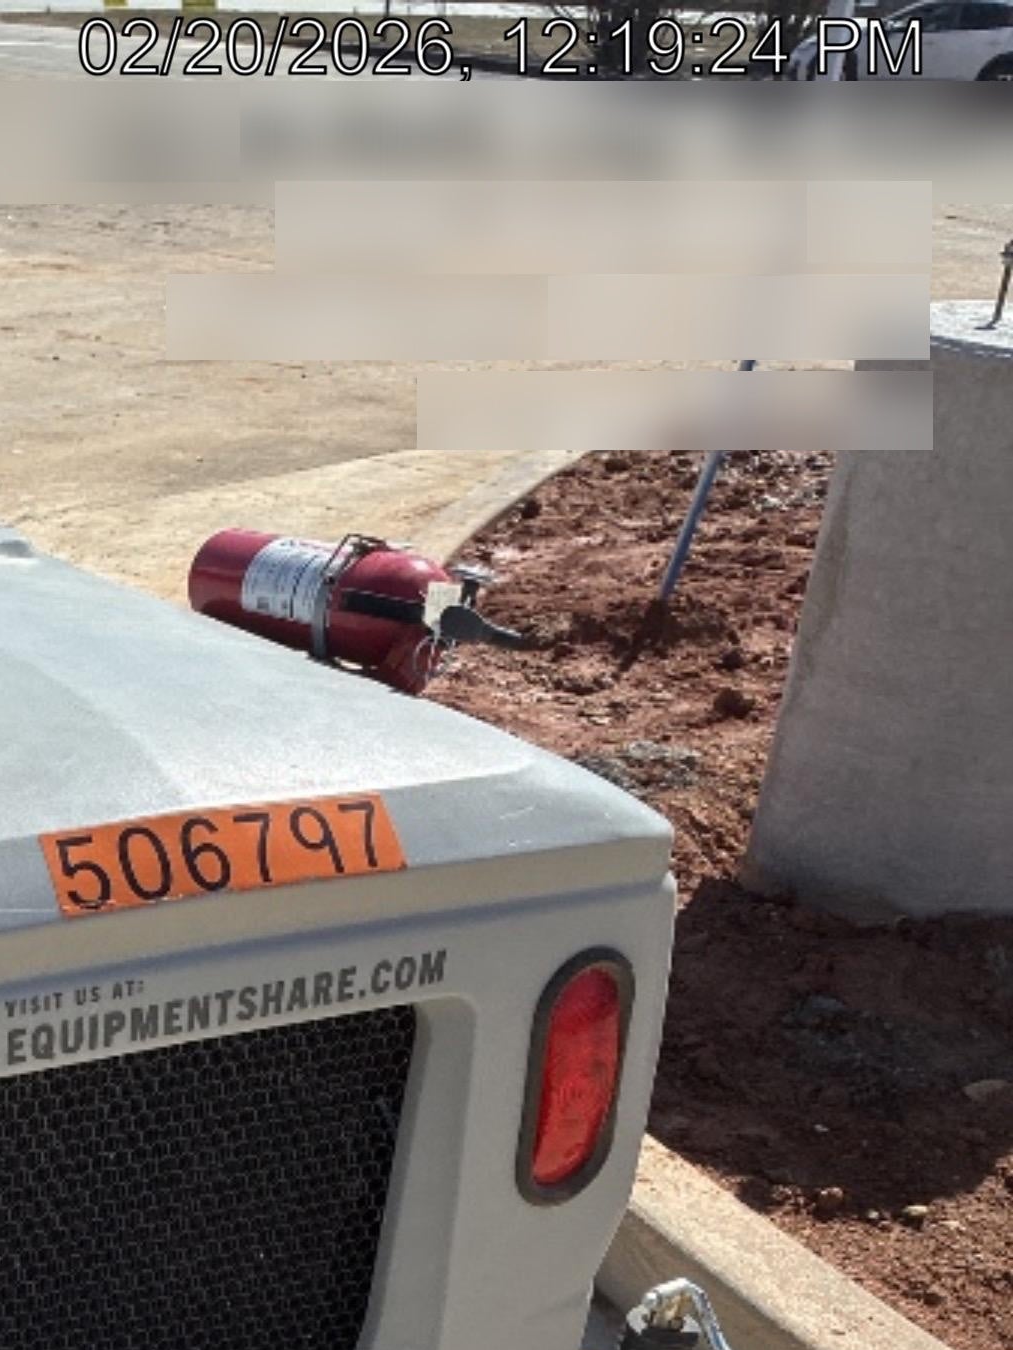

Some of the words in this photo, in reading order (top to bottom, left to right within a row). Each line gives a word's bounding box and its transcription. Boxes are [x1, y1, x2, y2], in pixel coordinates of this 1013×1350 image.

[55, 799, 380, 910] 506797
[5, 992, 63, 1018] VISIT
[74, 986, 101, 1006] US
[112, 979, 145, 1000] AT:
[6, 949, 448, 1065] EQUIPMENTSHARE.COM
